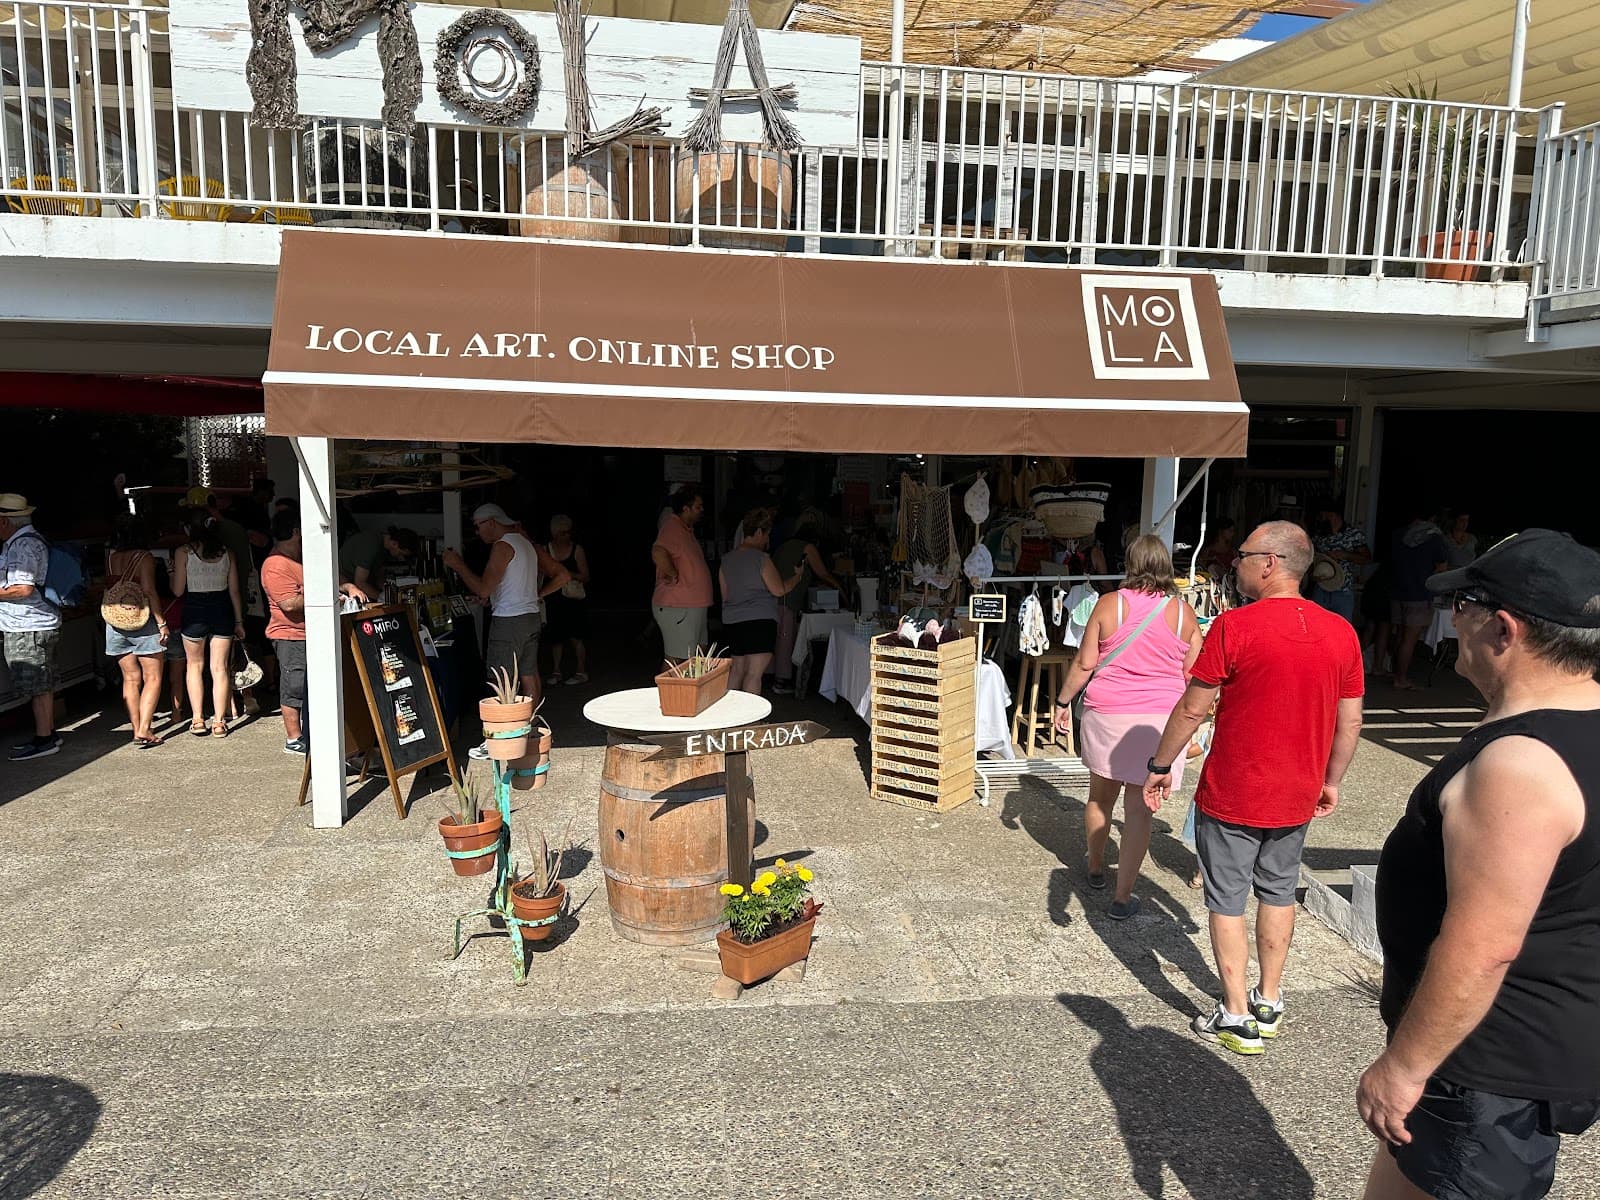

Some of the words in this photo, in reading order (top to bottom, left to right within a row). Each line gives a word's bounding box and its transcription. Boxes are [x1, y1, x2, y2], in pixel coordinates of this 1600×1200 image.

[246, 0, 803, 156] MOLA
[304, 324, 450, 358] LOCAL
[460, 332, 556, 359] ART.
[569, 337, 720, 370] ONLINE
[732, 345, 835, 371] SHOP
[374, 618, 400, 633] MIRÓ
[687, 724, 808, 757] ENTRADA
